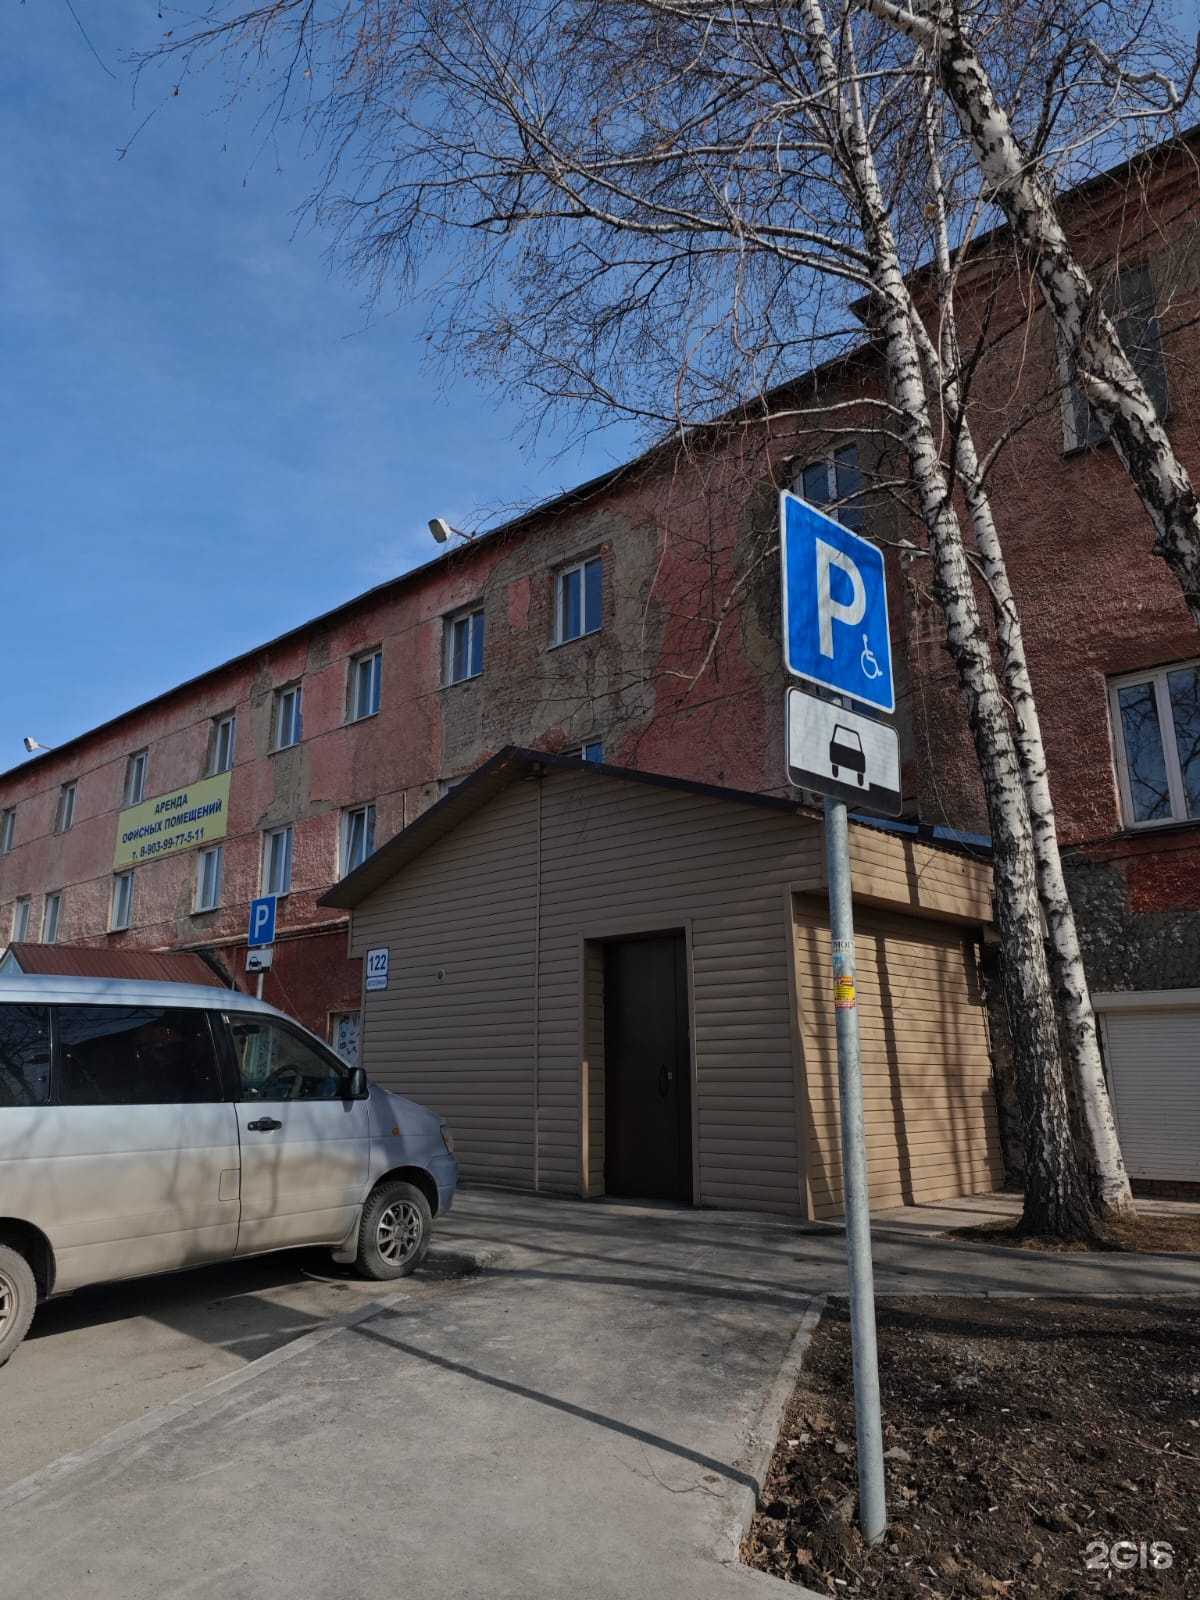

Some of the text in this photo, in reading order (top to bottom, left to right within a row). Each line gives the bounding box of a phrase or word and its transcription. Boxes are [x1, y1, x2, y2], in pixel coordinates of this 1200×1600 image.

[816, 537, 866, 660] P
[122, 798, 223, 844] ОФИСНЫХ ПОМЕЩЕНИЙ
[155, 793, 188, 815] АРЕНДА
[254, 905, 269, 939] P
[369, 954, 386, 971] 122
